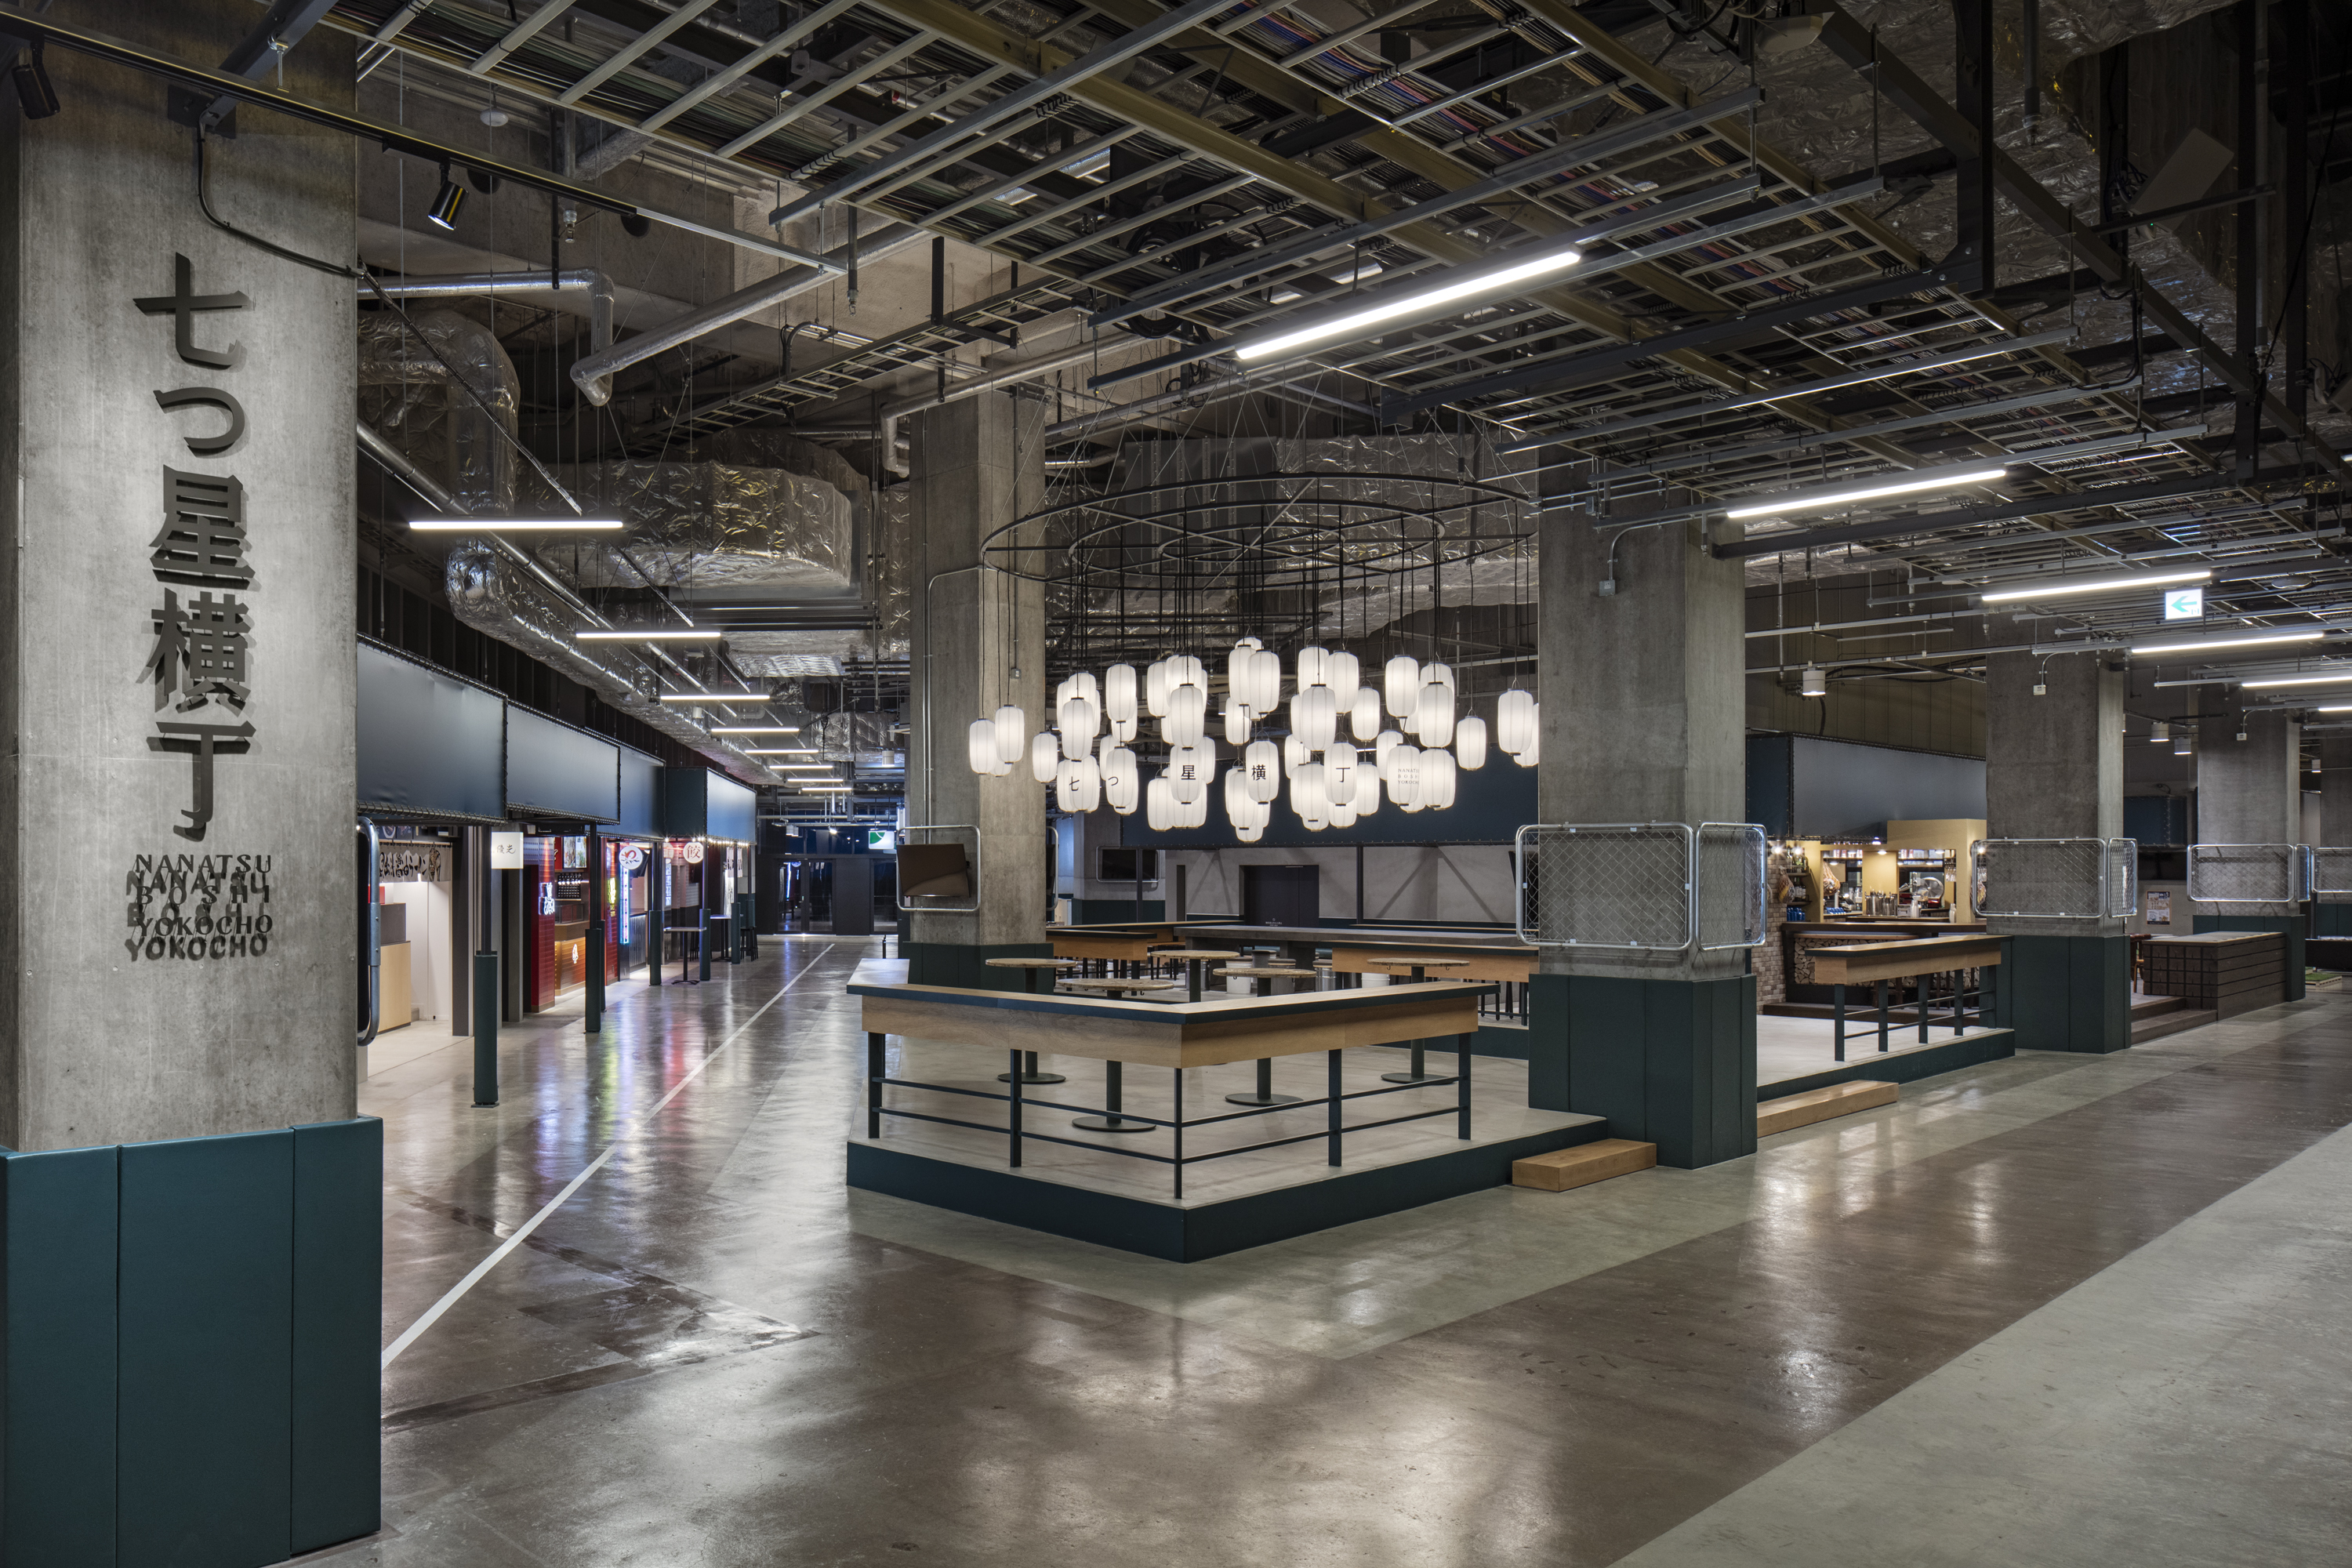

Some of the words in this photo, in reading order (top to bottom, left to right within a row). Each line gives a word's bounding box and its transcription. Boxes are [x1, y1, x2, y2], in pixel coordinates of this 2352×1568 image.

[132, 251, 256, 823] 七つ星横丁
[1181, 764, 1196, 780] 星
[1250, 764, 1267, 782] 横
[1335, 766, 1351, 783] 丁
[136, 854, 271, 873] NANATSU
[136, 884, 270, 906] BOSHI
[136, 914, 273, 937] YOKOCHO
